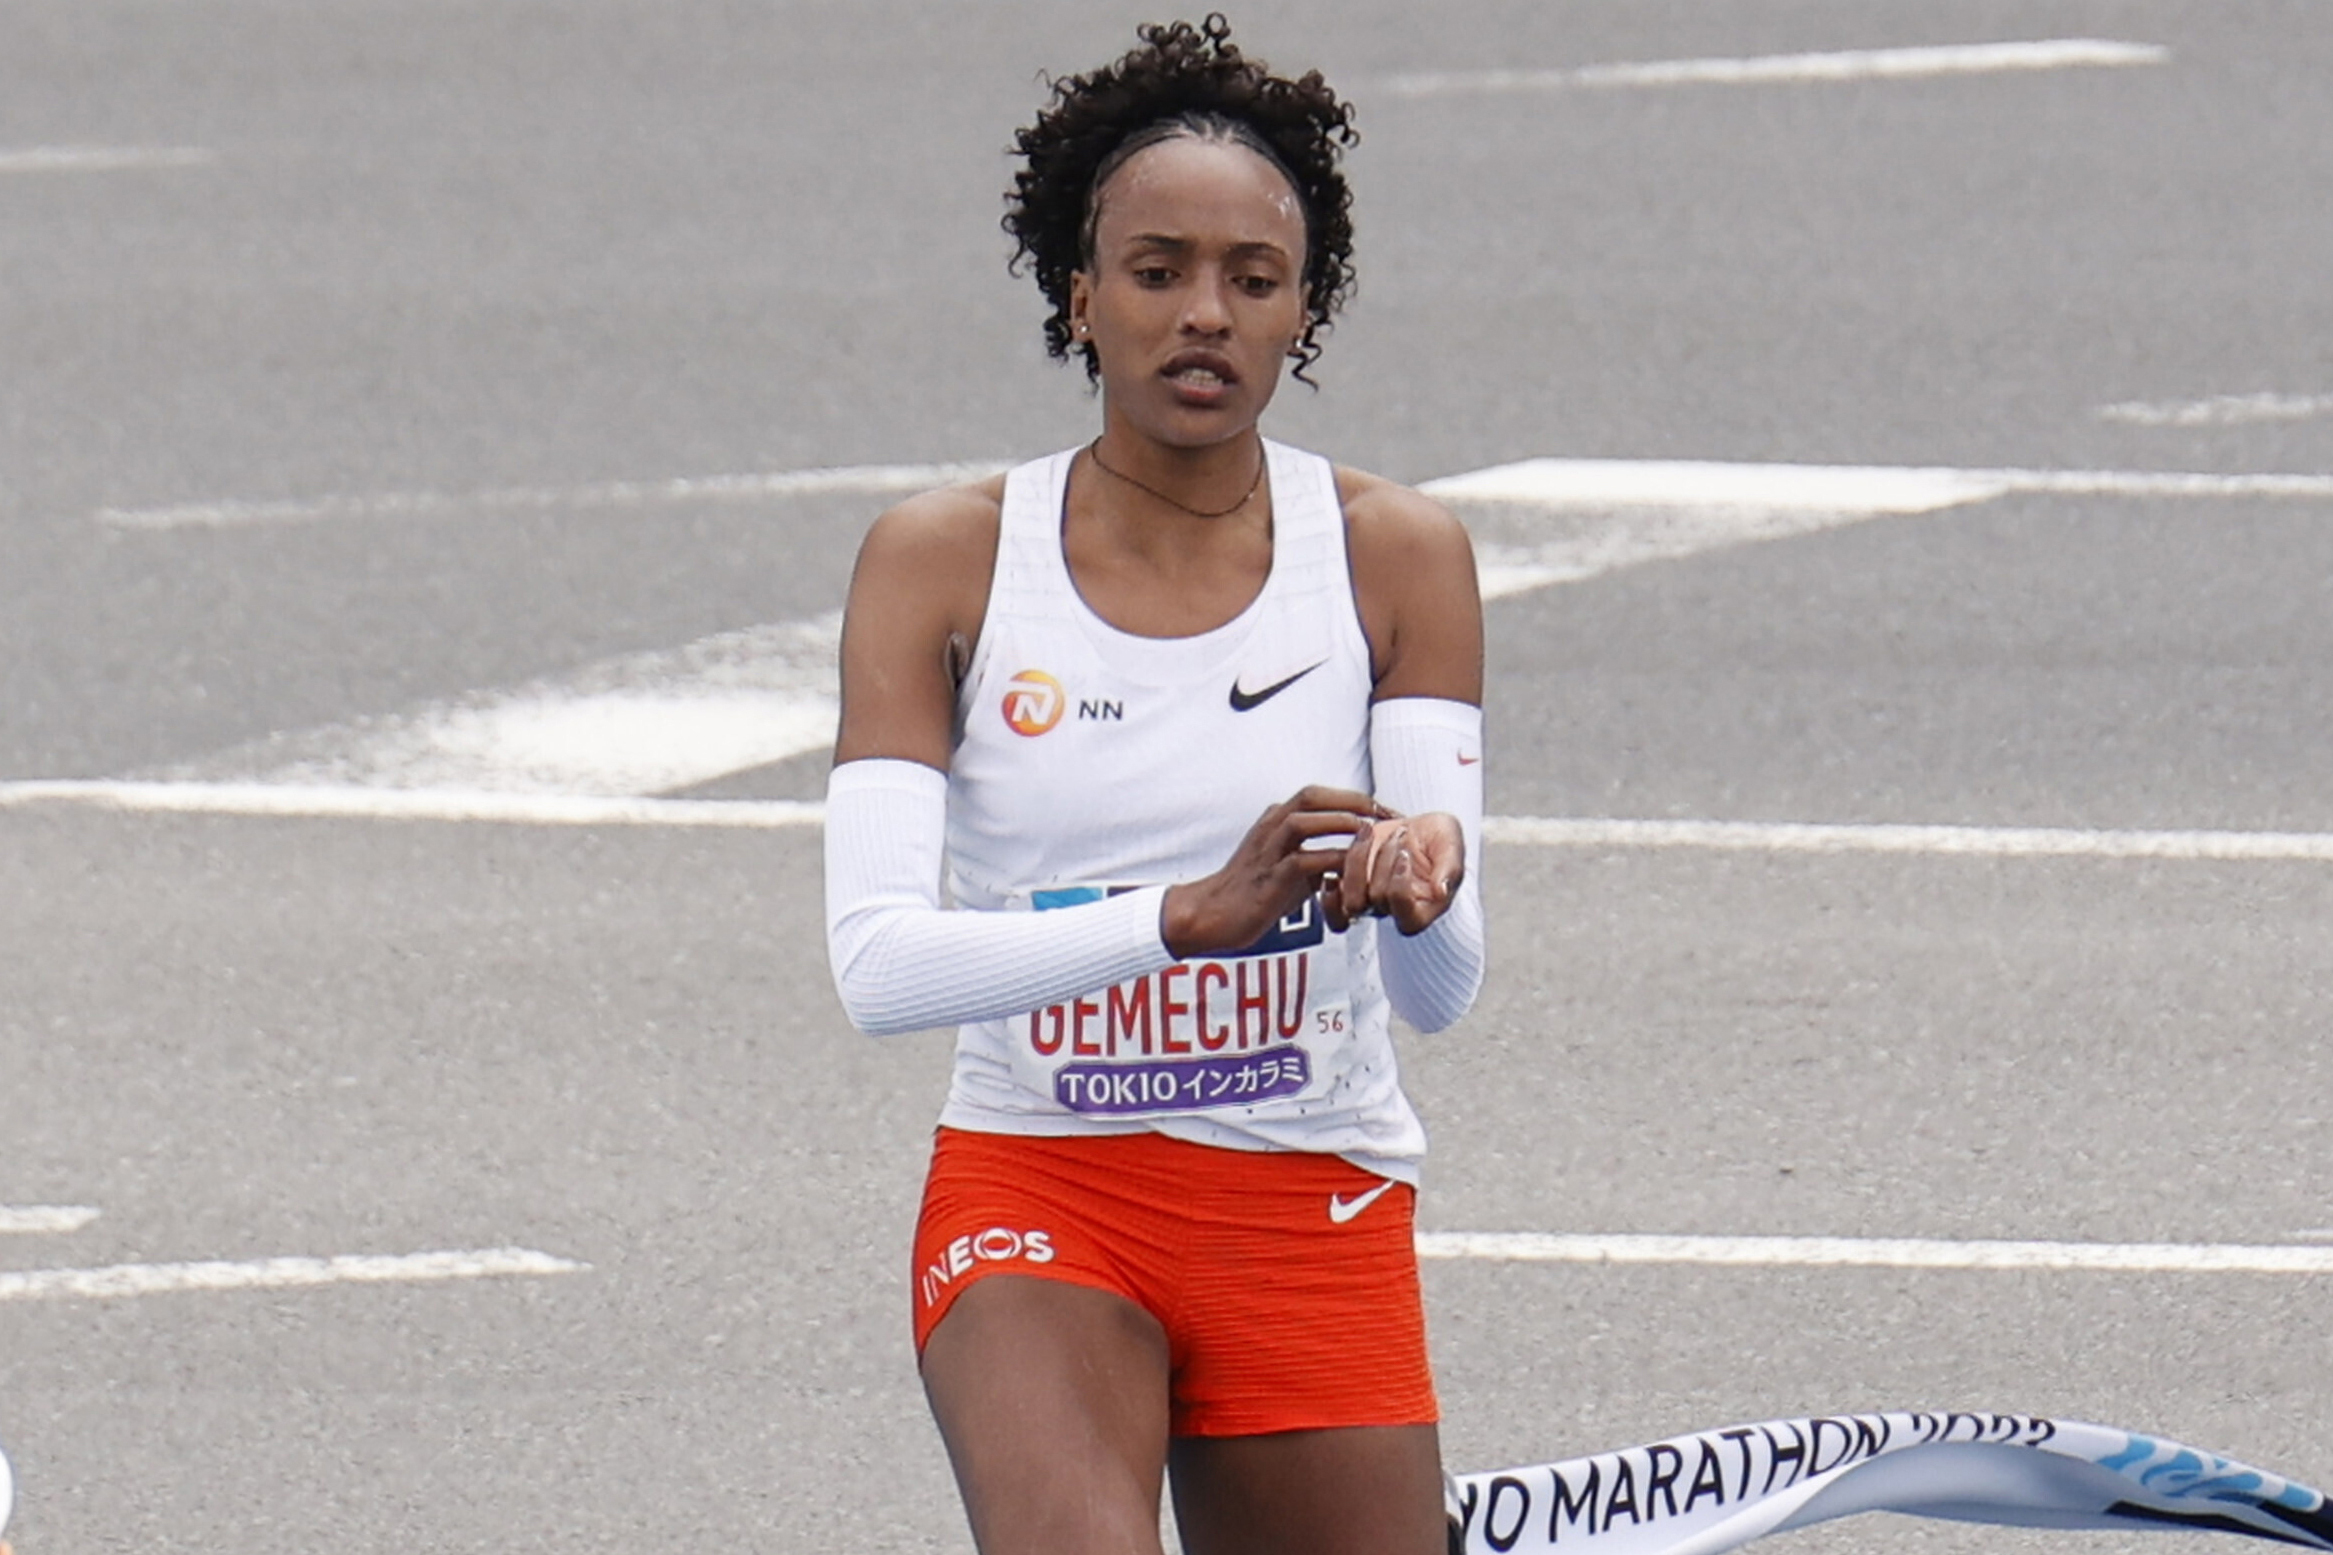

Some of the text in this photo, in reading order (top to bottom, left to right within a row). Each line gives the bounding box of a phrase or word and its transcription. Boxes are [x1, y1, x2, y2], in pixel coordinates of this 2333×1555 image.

[1079, 699, 1123, 720] NN
[1030, 952, 1308, 1057] GEMECHU
[1316, 1009, 1344, 1034] 56
[1060, 1056, 1305, 1105] TOKIO インカラミ
[922, 1227, 1055, 1308] INEOS
[1548, 1416, 1891, 1544] MARATHON
